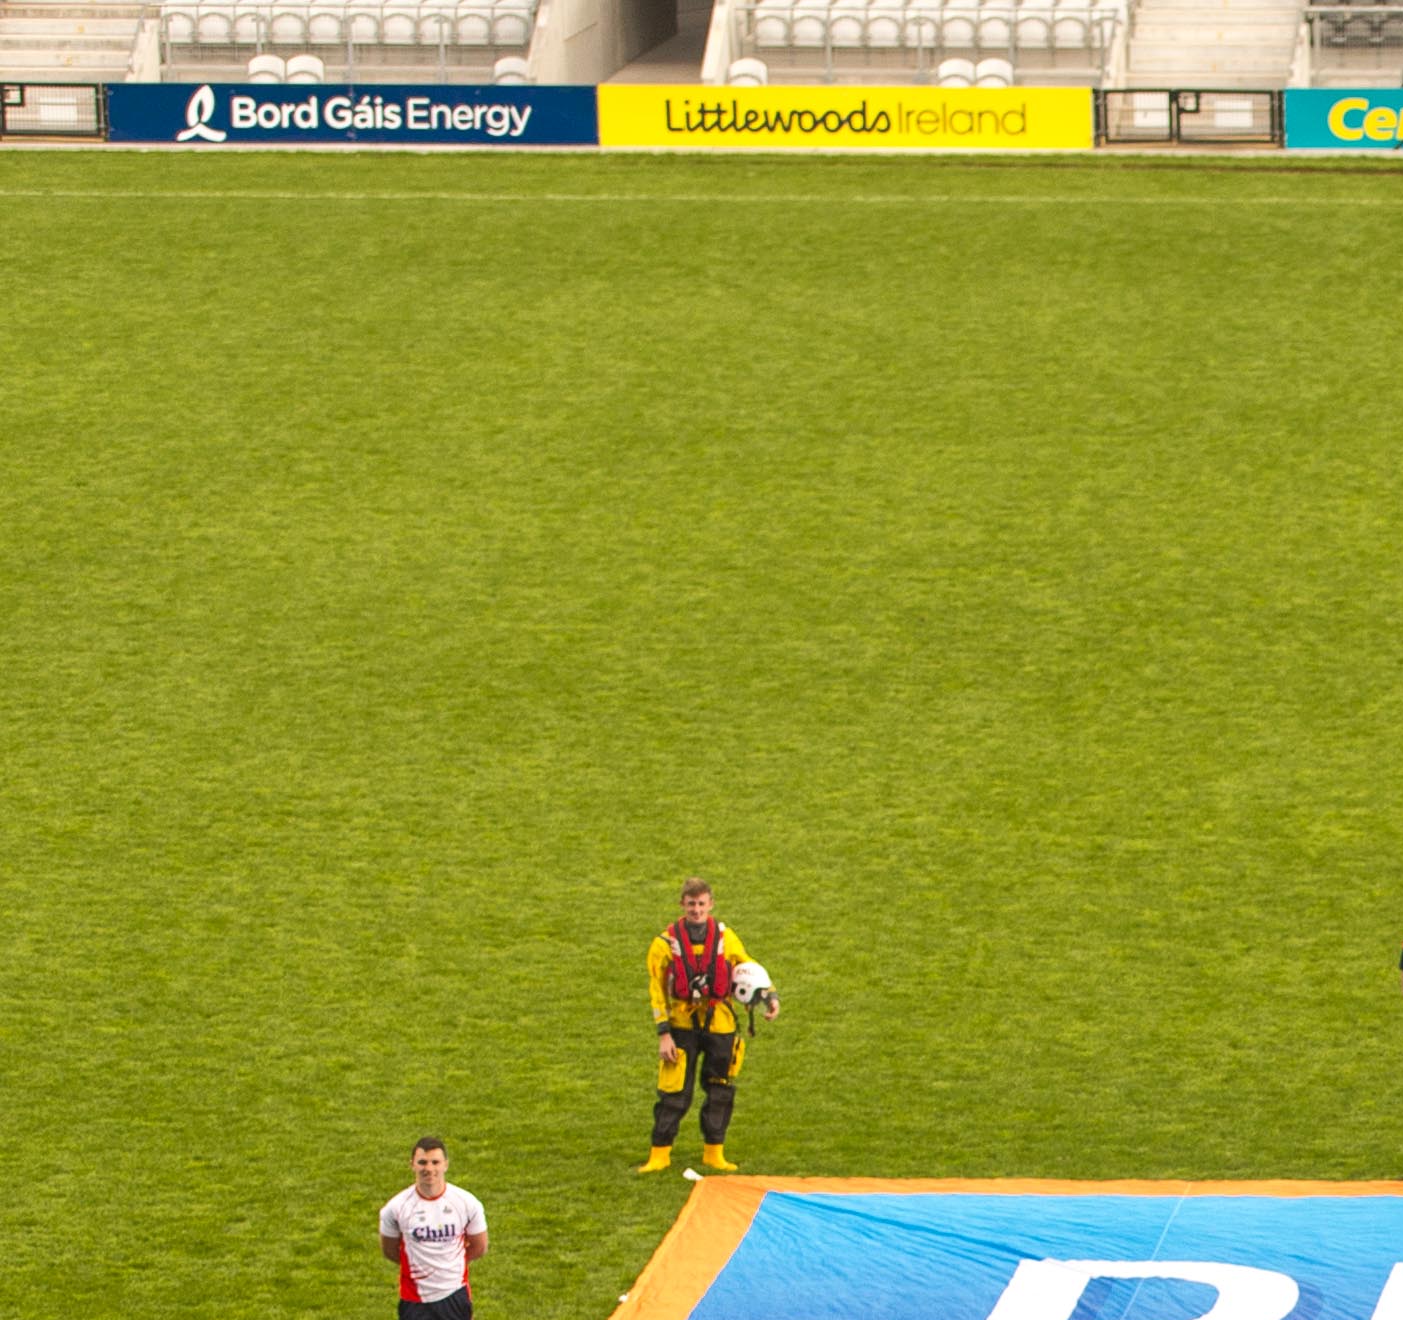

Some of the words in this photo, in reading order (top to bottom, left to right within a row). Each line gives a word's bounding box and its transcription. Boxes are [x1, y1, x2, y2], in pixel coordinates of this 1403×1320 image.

[230, 95, 320, 130] Bord
[323, 93, 402, 130] Gáis
[406, 97, 532, 137] Energy
[664, 98, 892, 134] Littlewoods
[412, 1224, 456, 1240] Chill
